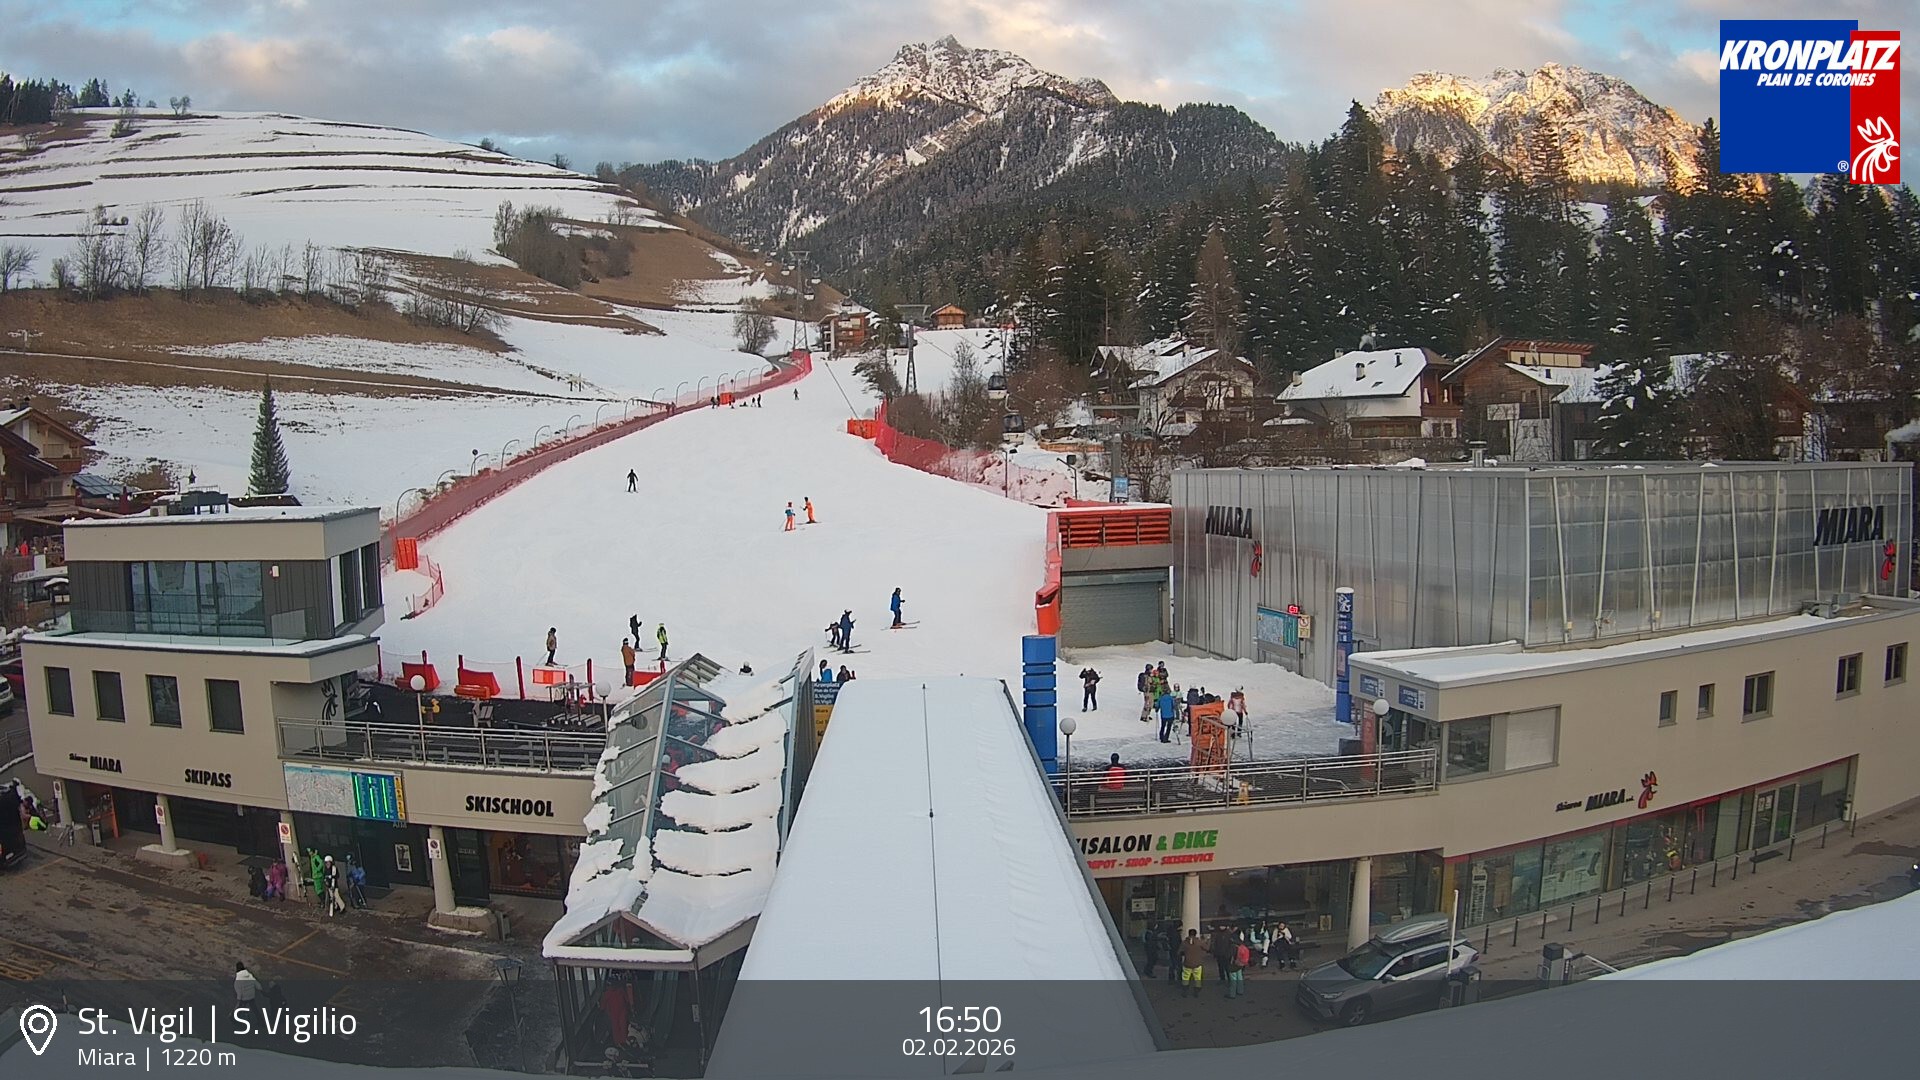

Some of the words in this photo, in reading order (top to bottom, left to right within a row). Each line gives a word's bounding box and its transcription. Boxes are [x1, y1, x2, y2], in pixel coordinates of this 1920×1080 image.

[1205, 505, 1252, 539] MIARA
[1812, 505, 1884, 547] MIARA
[90, 755, 122, 774] MIARA
[185, 769, 232, 788] SKIPASS
[465, 795, 554, 817] SKISCHOOL
[1585, 788, 1626, 812] MIARA
[1076, 834, 1152, 855] ISALON
[1156, 835, 1167, 851] &
[1172, 830, 1218, 850] BIKE
[1125, 857, 1152, 868] SHOP
[1161, 853, 1214, 865] SKISERVICE
